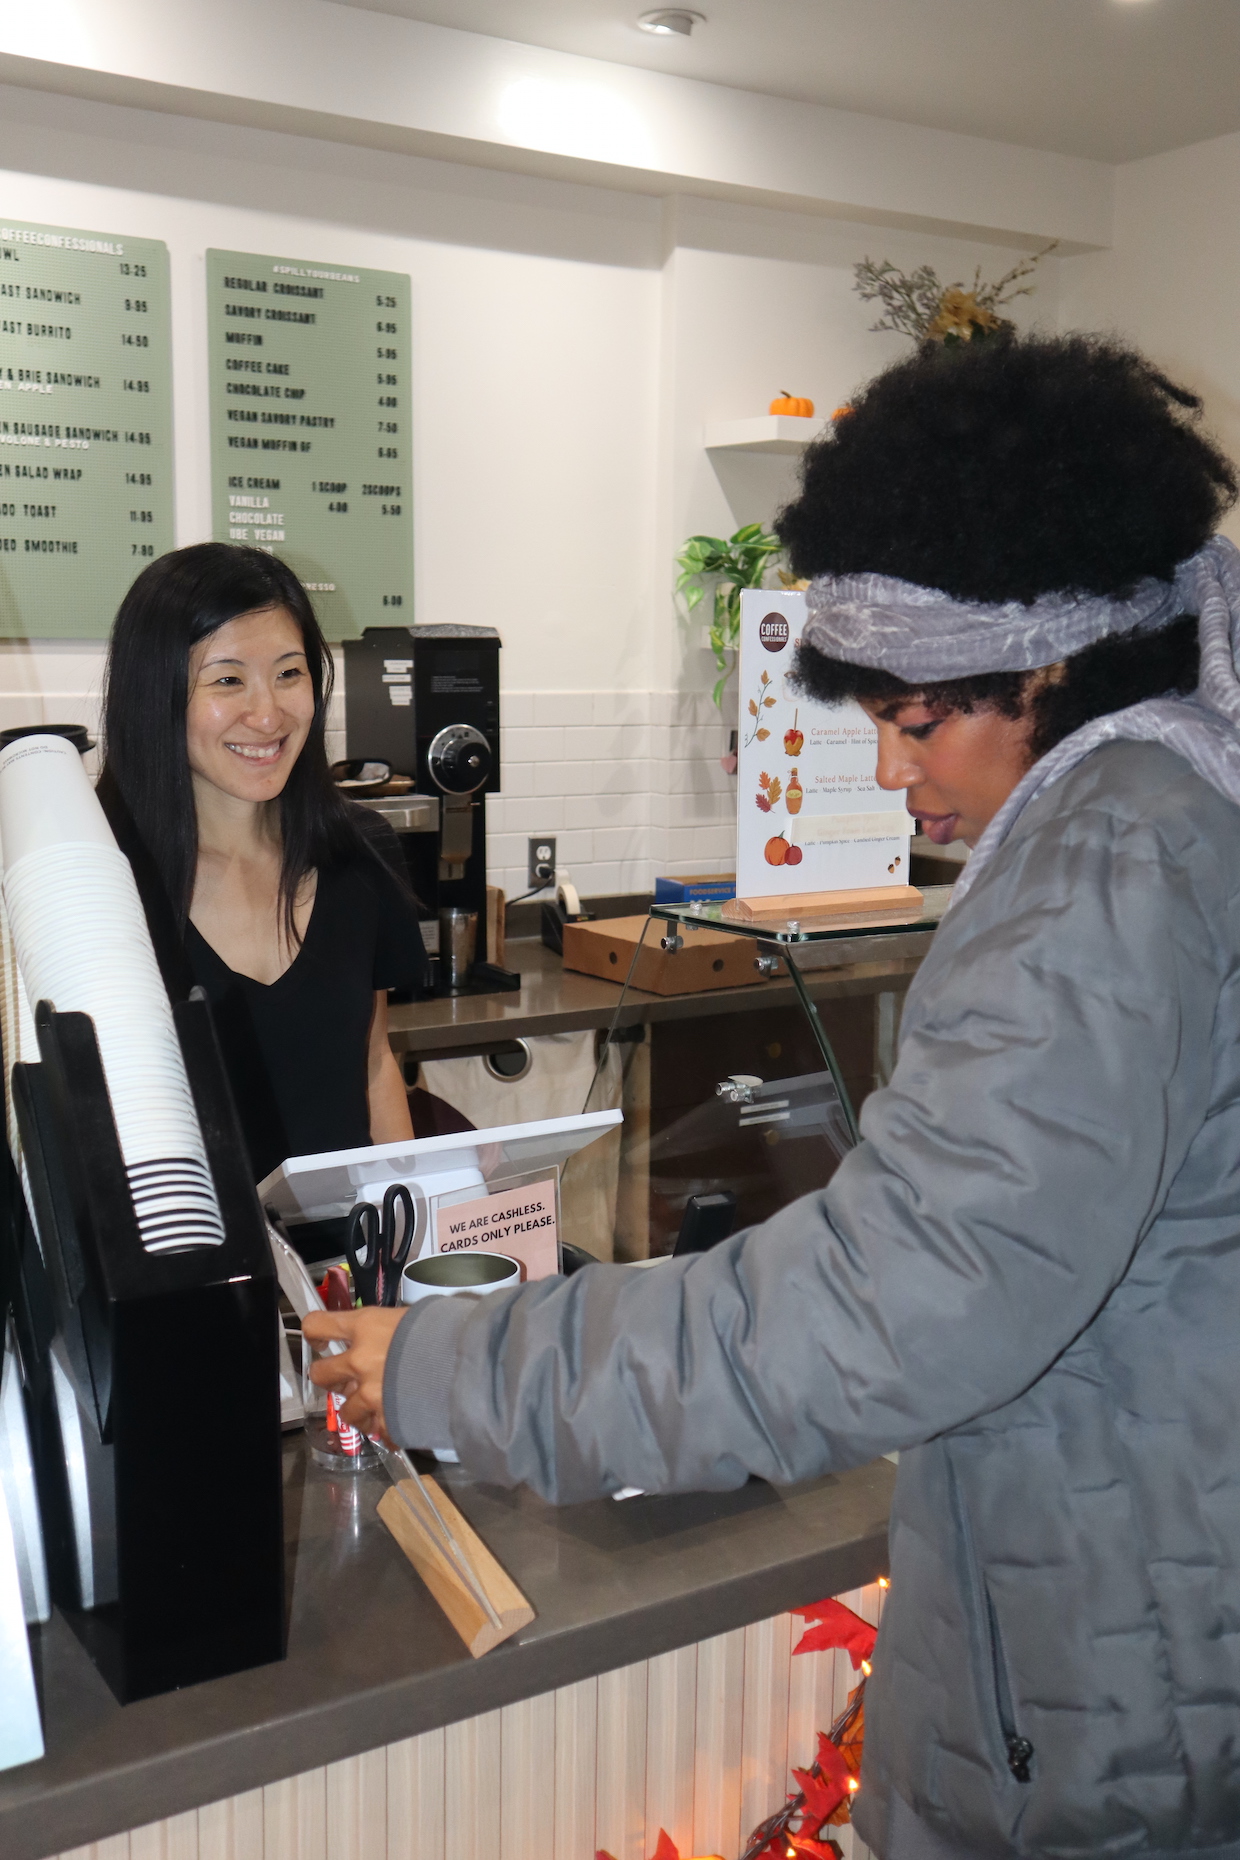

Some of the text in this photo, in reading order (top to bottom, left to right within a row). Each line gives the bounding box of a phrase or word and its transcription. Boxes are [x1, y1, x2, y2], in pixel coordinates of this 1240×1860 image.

[0, 246, 19, 261] WL
[224, 276, 267, 293] REGULAR
[273, 282, 324, 299] CROISSANT
[26, 287, 81, 305] SANDWICH
[225, 304, 261, 318] SAVORY
[265, 308, 316, 324] CROISSANT
[27, 323, 72, 339] BURRITO
[225, 331, 263, 346] MUFFIN
[226, 358, 262, 373] COFFEE
[266, 363, 290, 376] CAKE
[18, 369, 42, 383] BRIE
[46, 372, 101, 389] SANDWICH
[18, 382, 53, 394] APPLE
[226, 382, 281, 398] CHOCOLATE
[284, 388, 305, 399] CHIP
[227, 409, 258, 423] VEGAN
[261, 412, 296, 426] SAVORY
[300, 415, 334, 429] PASTRY
[13, 422, 60, 439] SAUSAGE
[65, 426, 119, 442] SANDWICH
[55, 438, 90, 450] PESTO
[228, 436, 258, 449] VEGAN
[261, 438, 297, 452] MUFFIN
[15, 465, 49, 480] SALAD
[53, 467, 83, 481] WRAP
[228, 476, 244, 488] ICE
[247, 477, 280, 490] CREAM
[319, 481, 347, 494] SCOOP
[229, 495, 270, 508] VANILLA
[0, 503, 15, 517] DO
[23, 504, 56, 518] TOAST
[229, 512, 284, 525] CHOCOLATE
[229, 528, 285, 541] UBE VEGAN
[0, 538, 16, 551] ED
[24, 539, 78, 554] SMOOTHIE
[761, 623, 788, 636] COFFEE
[811, 728, 840, 736] Caramel
[842, 727, 861, 737] Apple
[815, 775, 836, 784] Salted
[838, 775, 858, 785] Maple
[838, 786, 852, 794] Syrup
[449, 1202, 545, 1234] WE ARE CASHLESS.
[440, 1215, 556, 1253] CARDS ONLY PLEASE.
